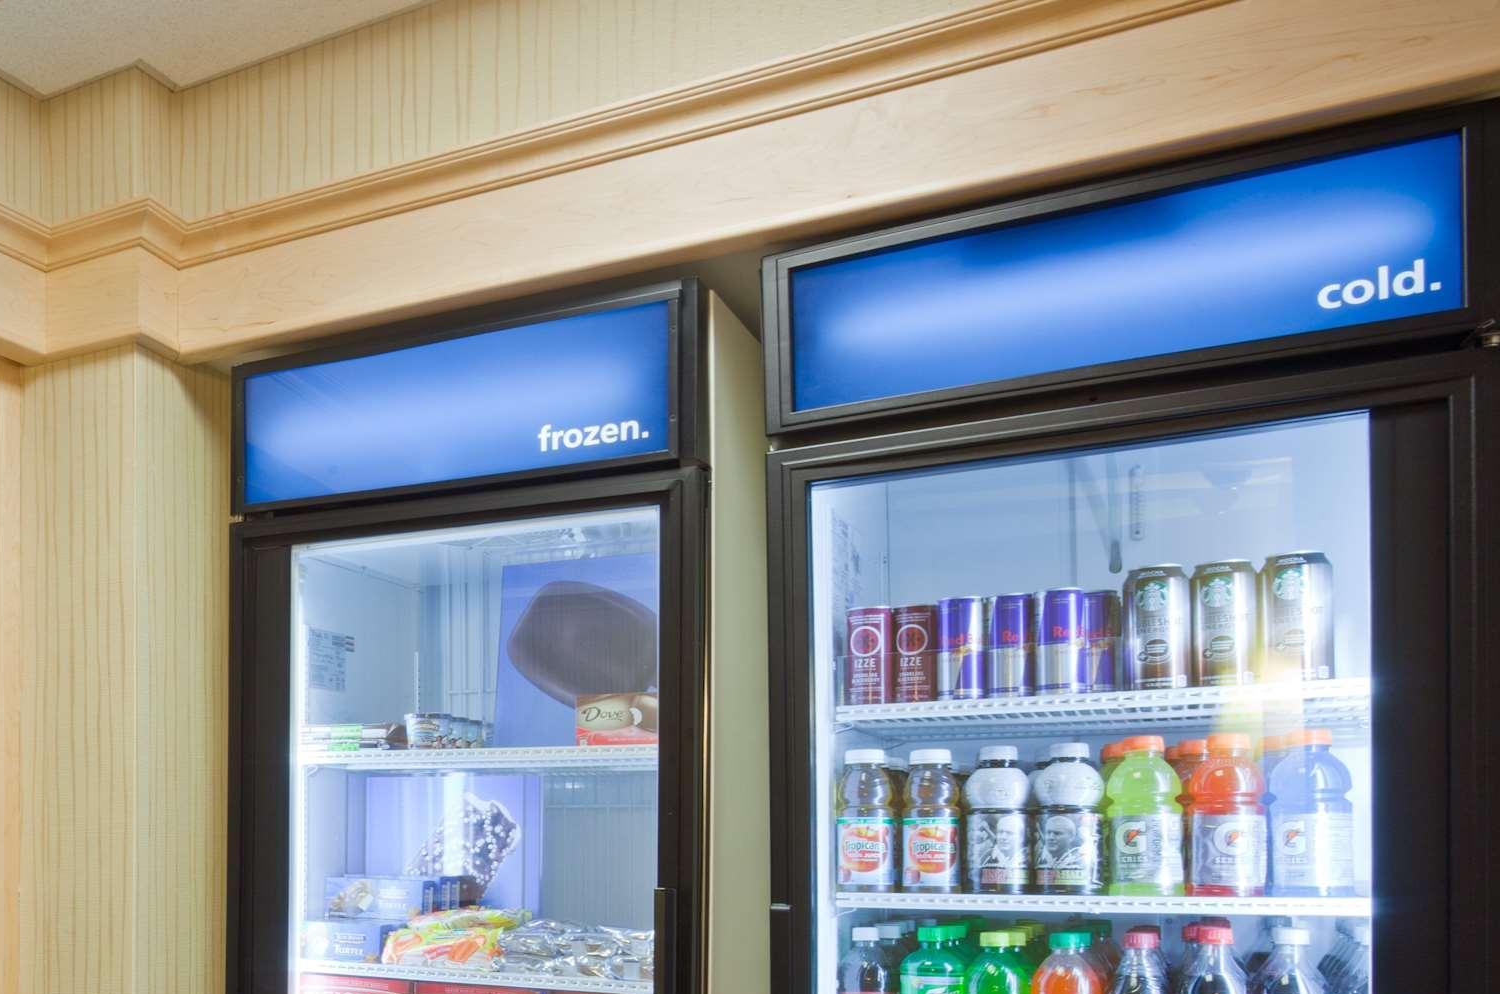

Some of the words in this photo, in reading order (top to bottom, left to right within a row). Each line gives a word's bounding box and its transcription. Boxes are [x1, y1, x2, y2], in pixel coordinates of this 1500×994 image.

[1317, 259, 1441, 310] cold.
[538, 419, 649, 452] frozen.
[854, 656, 877, 669] IZZE
[900, 656, 923, 668] IZZE
[582, 706, 625, 723] Dove
[1115, 821, 1147, 855] G
